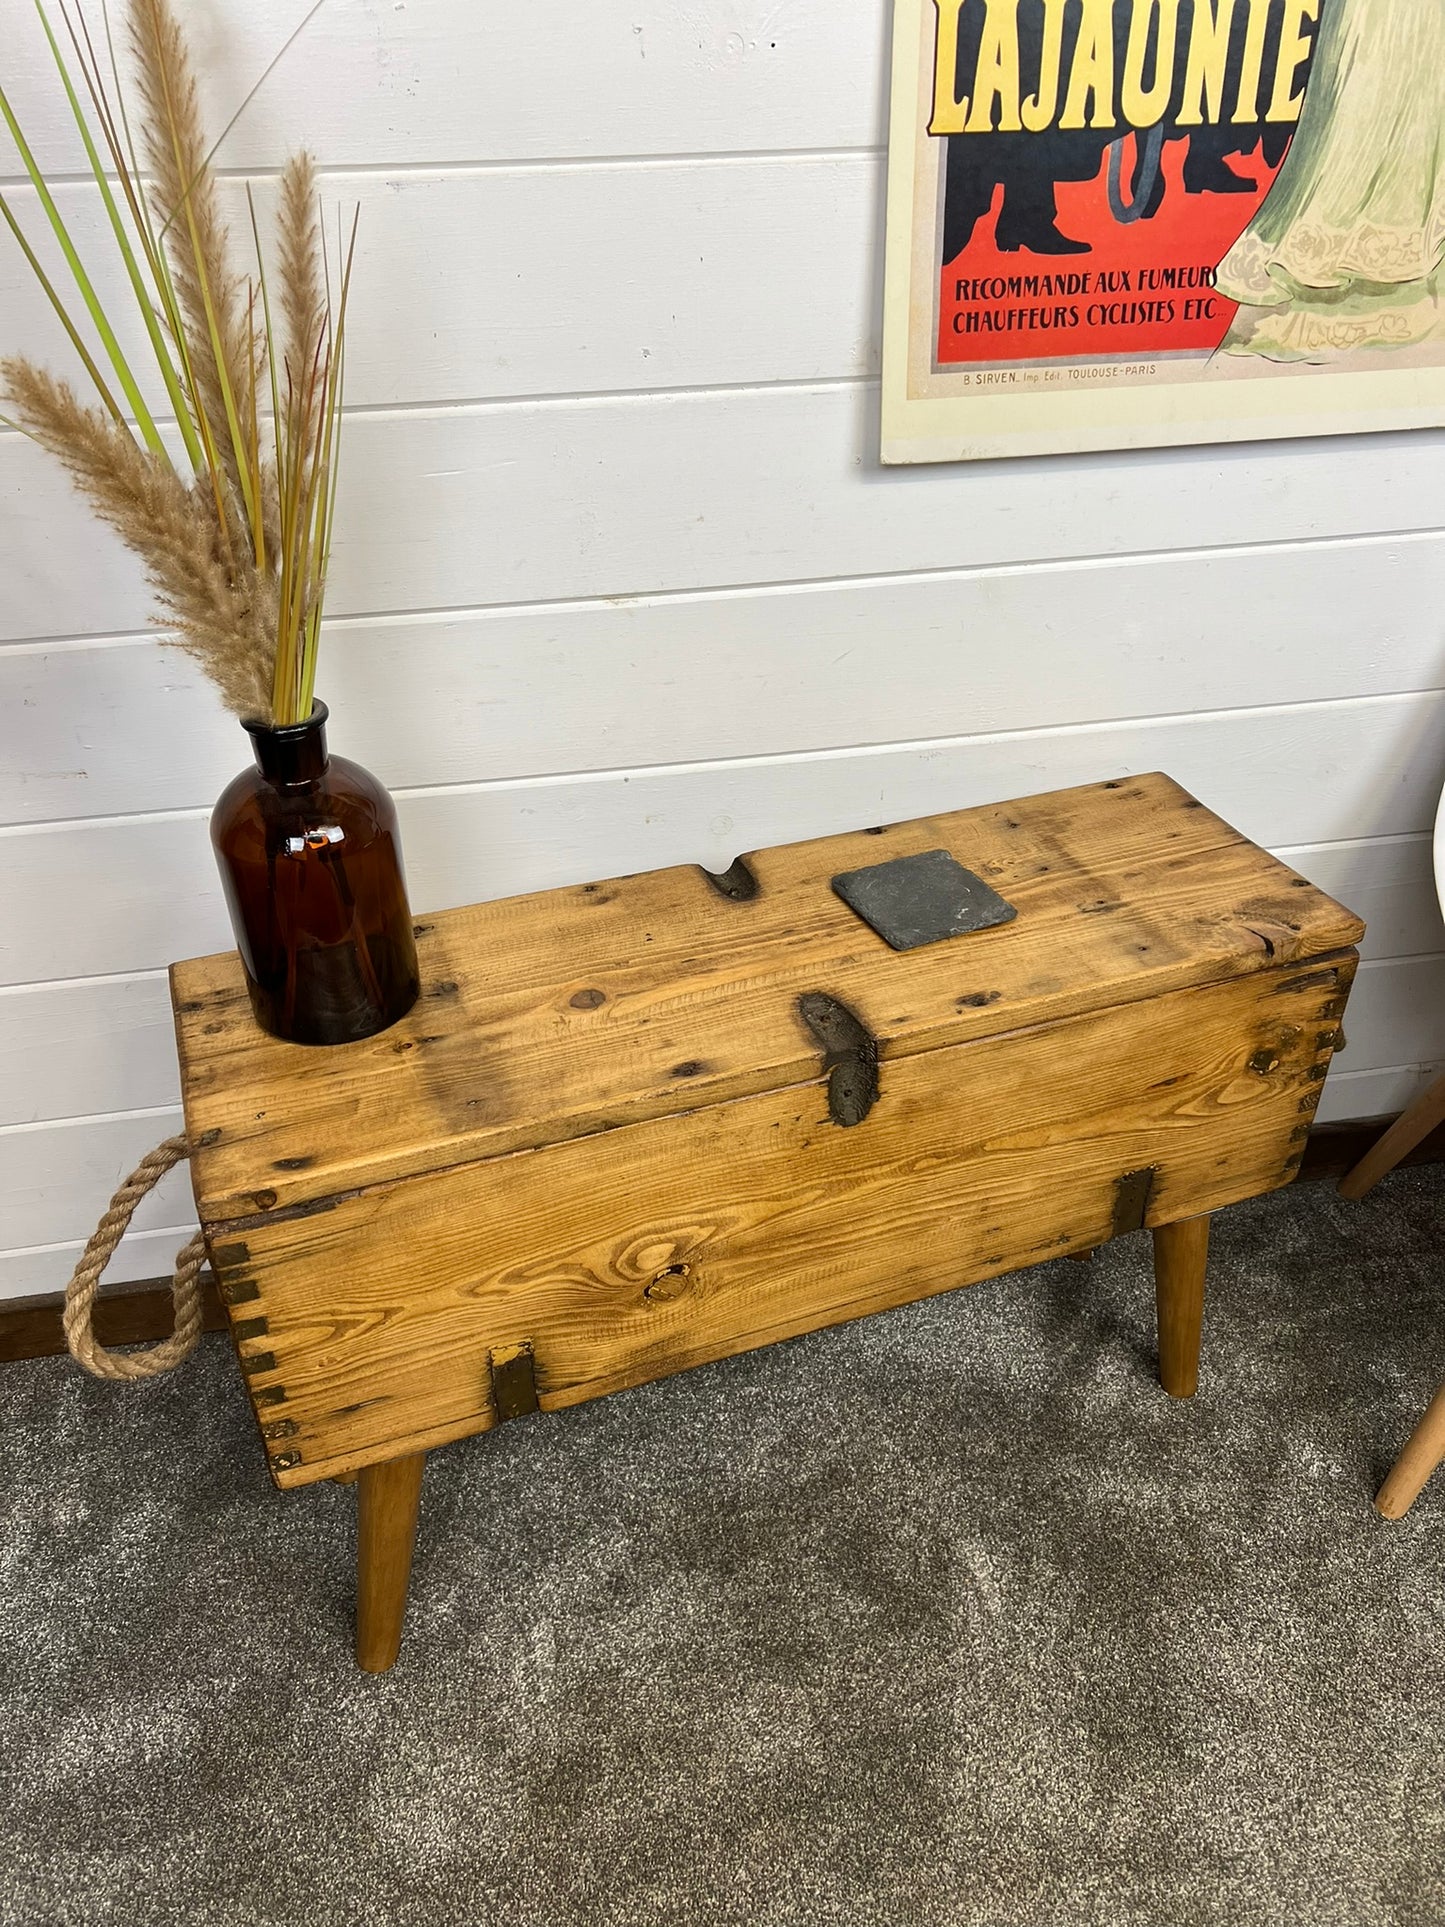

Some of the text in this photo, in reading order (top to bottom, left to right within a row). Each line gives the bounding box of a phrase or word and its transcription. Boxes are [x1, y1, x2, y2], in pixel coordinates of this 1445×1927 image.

[928, 0, 1319, 134] LAJAUNIE
[1094, 270, 1131, 294] AUX
[1138, 265, 1218, 291] FUMEURS
[953, 305, 1079, 334] CHAUFFEURS
[1087, 299, 1176, 326] CYCLISTES
